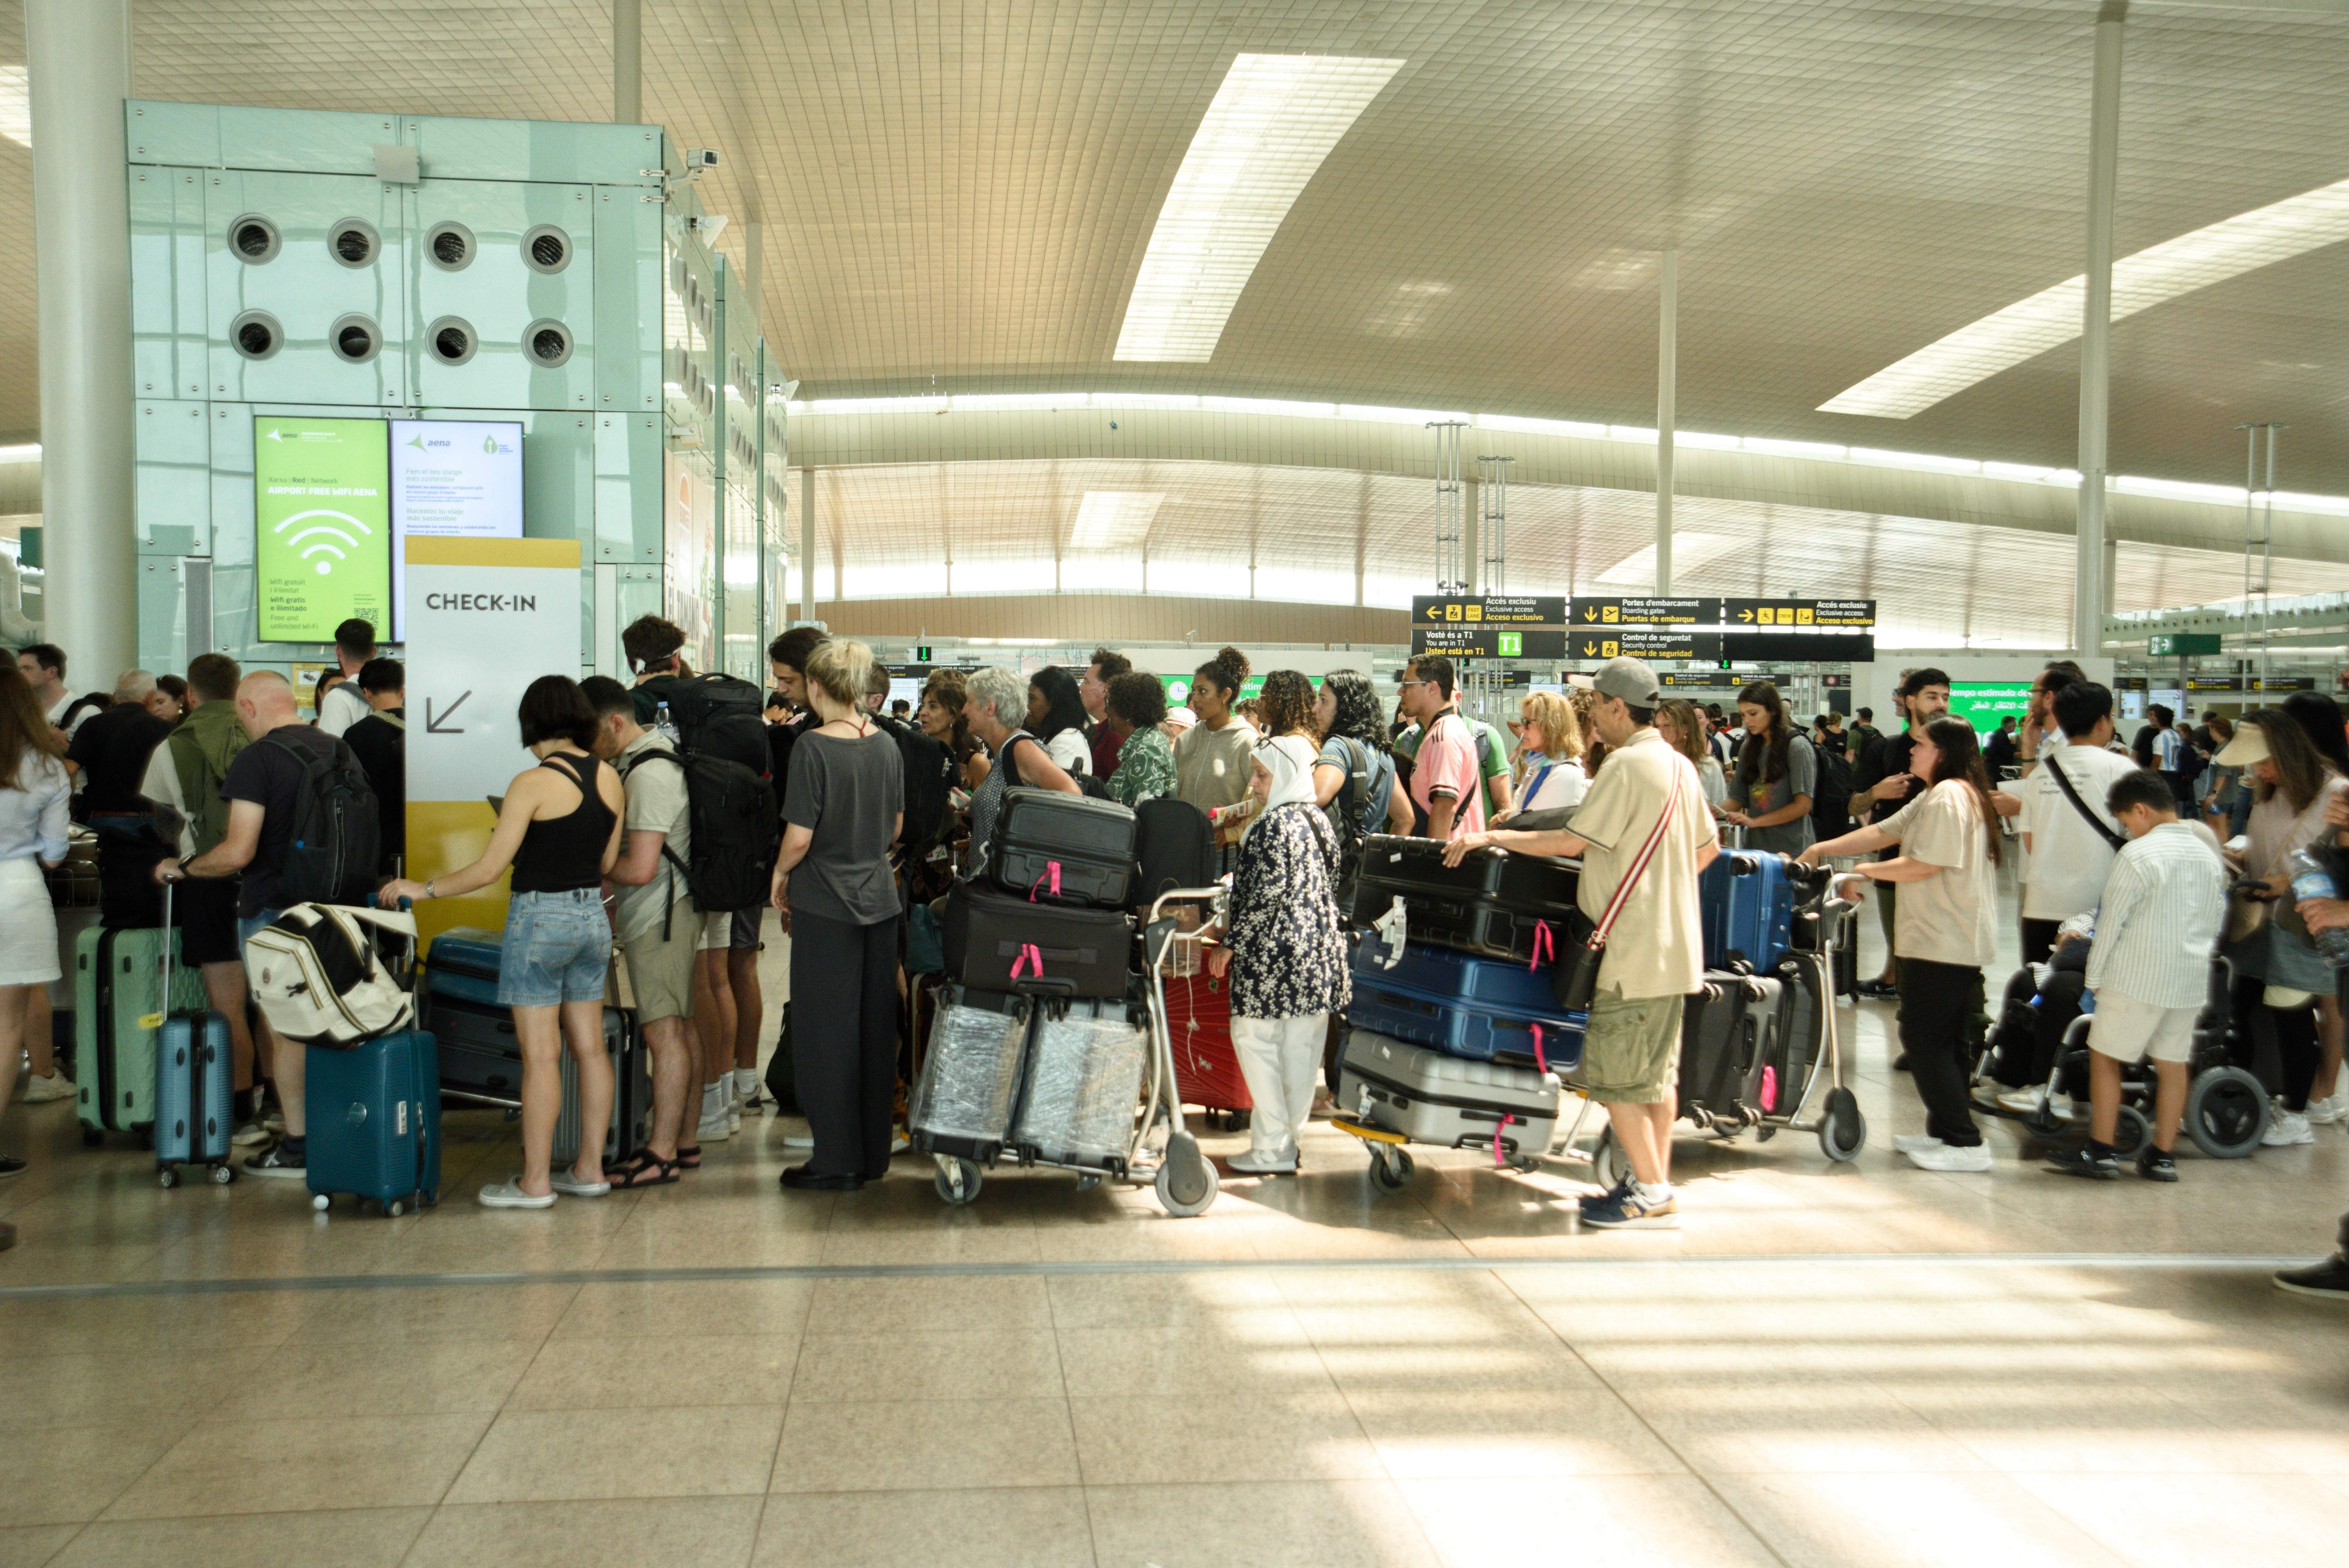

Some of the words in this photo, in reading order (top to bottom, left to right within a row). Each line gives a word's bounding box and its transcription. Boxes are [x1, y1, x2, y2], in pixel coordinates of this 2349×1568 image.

[268, 486, 307, 494] AIRPORT
[309, 487, 330, 495] FREE
[426, 593, 536, 612] CHECK-IN
[1659, 634, 1691, 643] seguretat
[1500, 636, 1520, 652] T1
[1950, 688, 1976, 697] iempo
[1978, 688, 2015, 697] estimado
